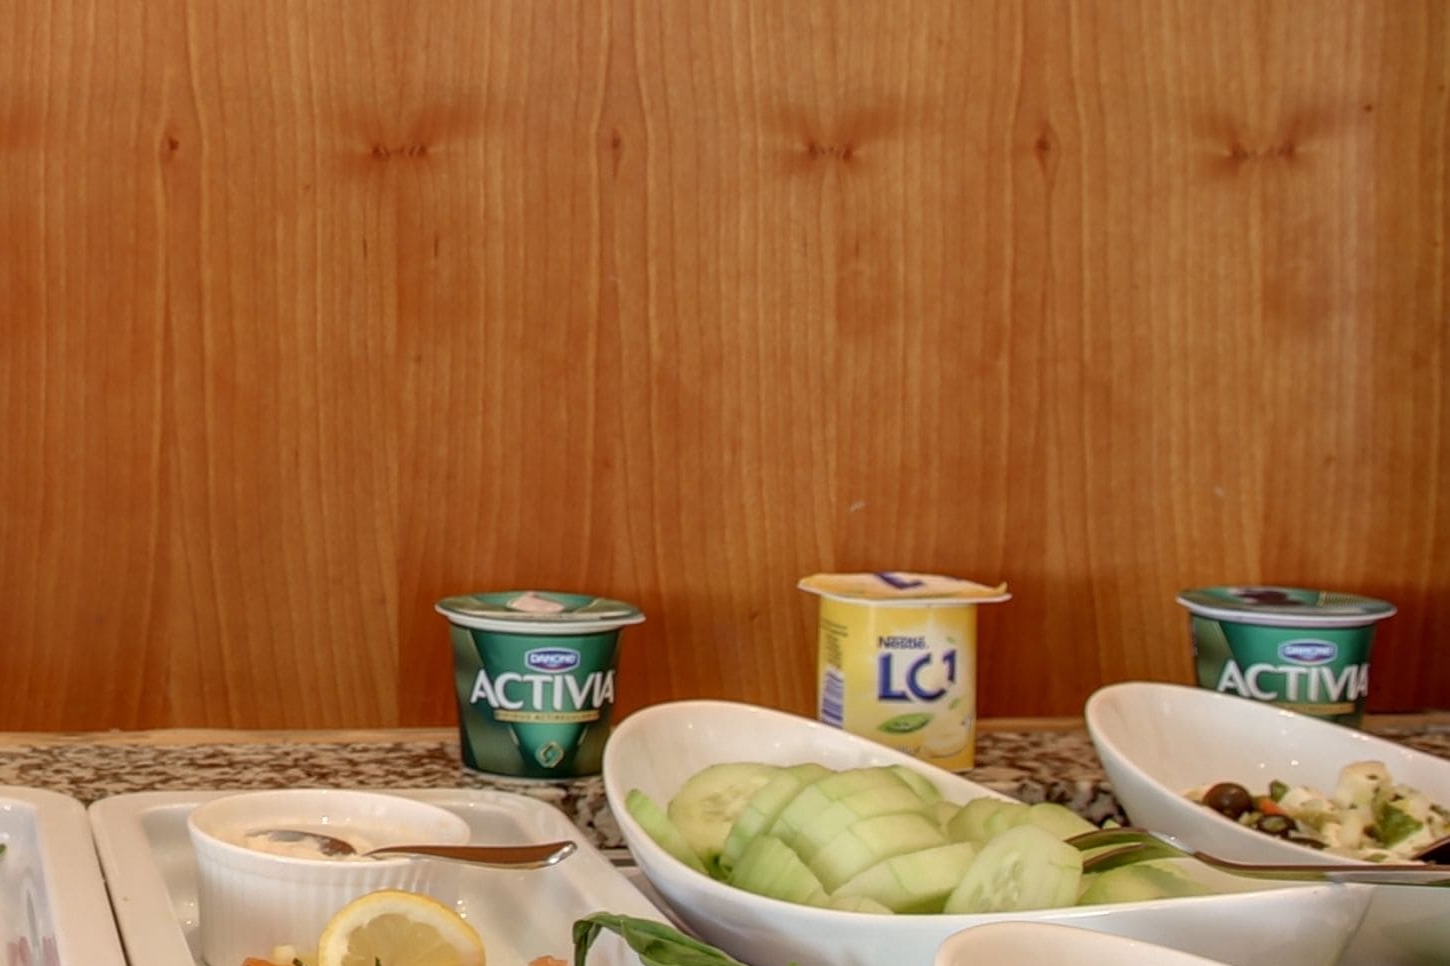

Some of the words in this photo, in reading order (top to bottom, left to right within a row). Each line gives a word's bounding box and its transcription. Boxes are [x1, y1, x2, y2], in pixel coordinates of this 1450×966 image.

[530, 653, 577, 664] DANONE
[877, 635, 927, 649] Nestlé
[470, 669, 615, 712] ACTIVIA
[877, 649, 957, 702] LC1
[1217, 659, 1370, 702] ACTIVIA
